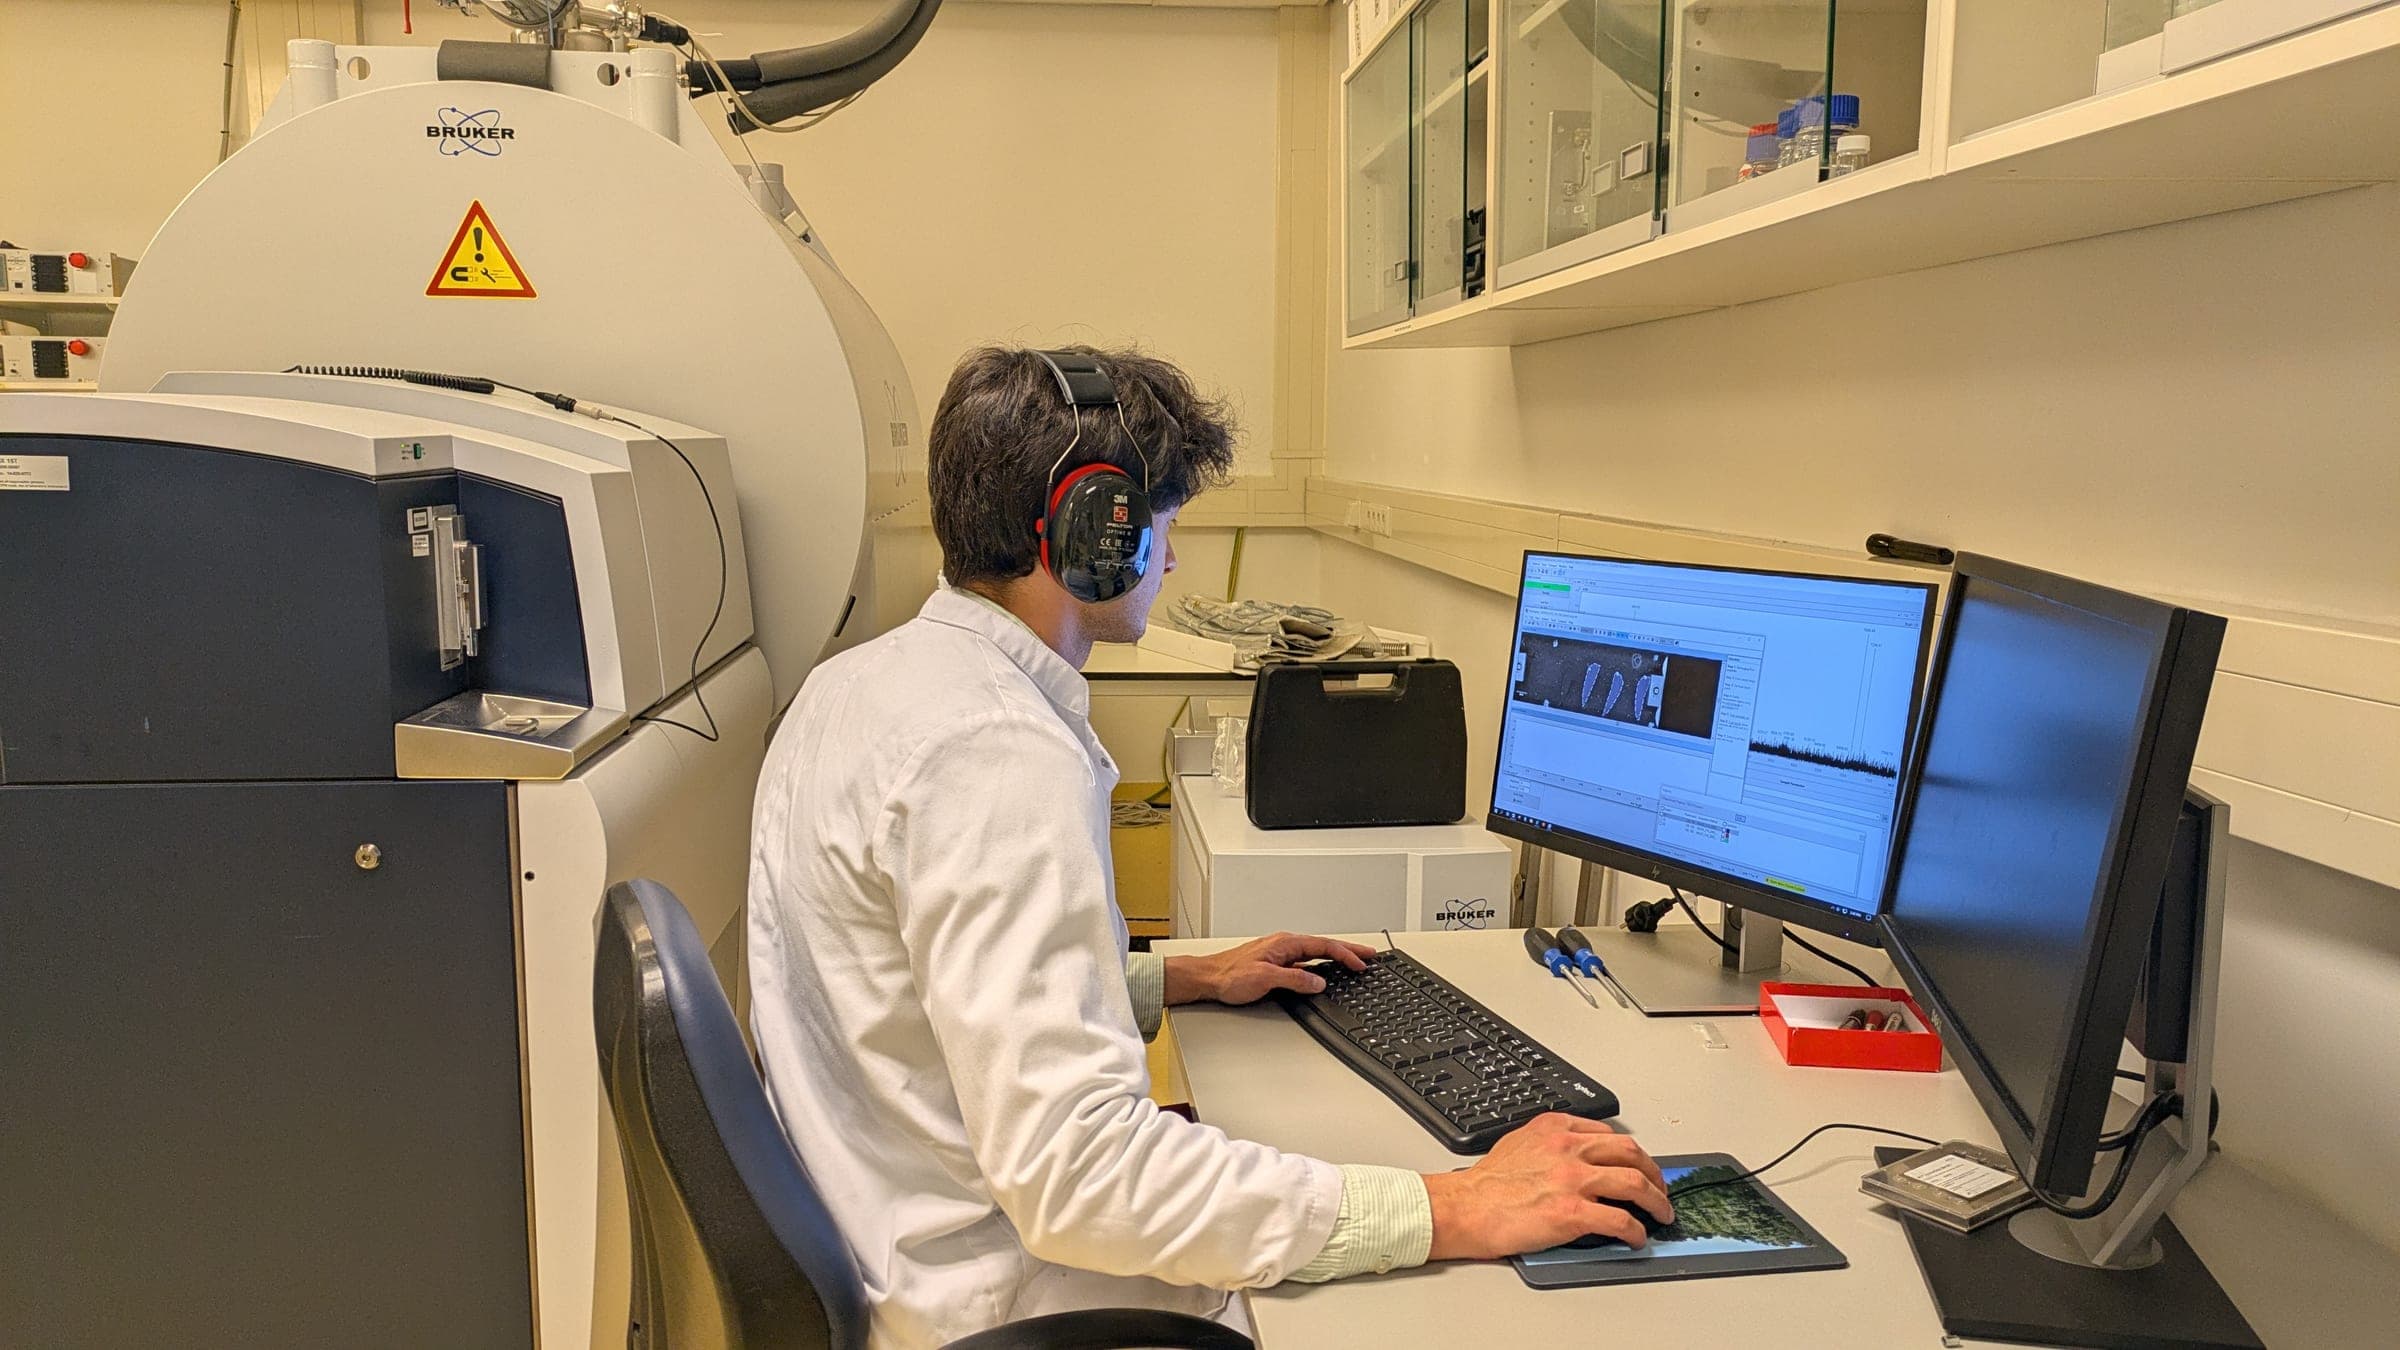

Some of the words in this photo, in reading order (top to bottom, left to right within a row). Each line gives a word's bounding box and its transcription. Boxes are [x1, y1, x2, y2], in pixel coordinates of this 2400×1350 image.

[426, 126, 515, 140] BRUKER
[1113, 494, 1128, 504] 3M
[1436, 909, 1496, 921] BRUKER
